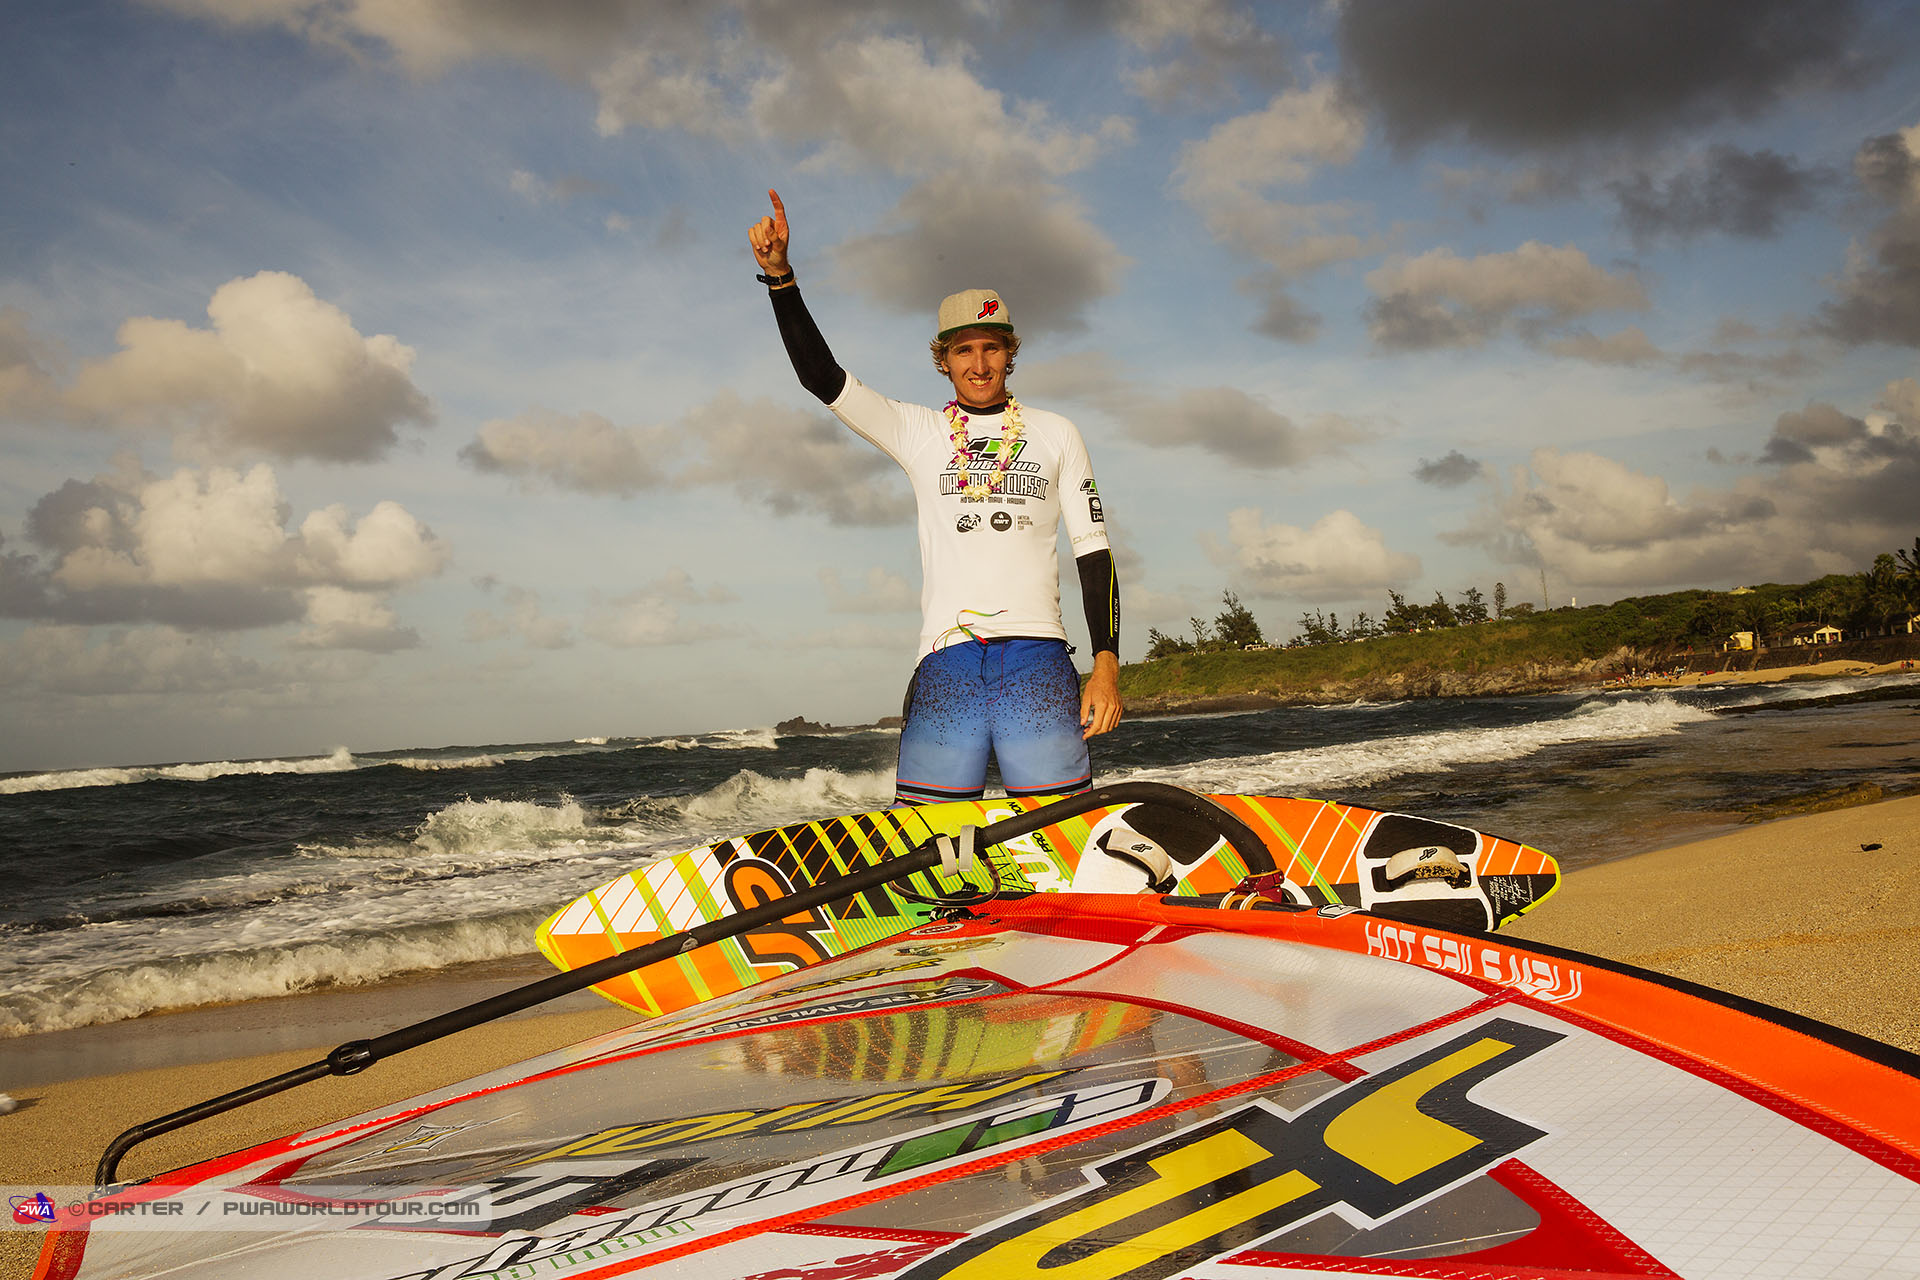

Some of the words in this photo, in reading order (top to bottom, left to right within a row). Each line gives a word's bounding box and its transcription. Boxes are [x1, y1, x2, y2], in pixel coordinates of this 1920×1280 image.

[978, 300, 998, 320] JP
[1006, 473, 1049, 501] CLASSIC
[1073, 530, 1107, 545] DAKIN
[1365, 921, 1416, 962] HOT
